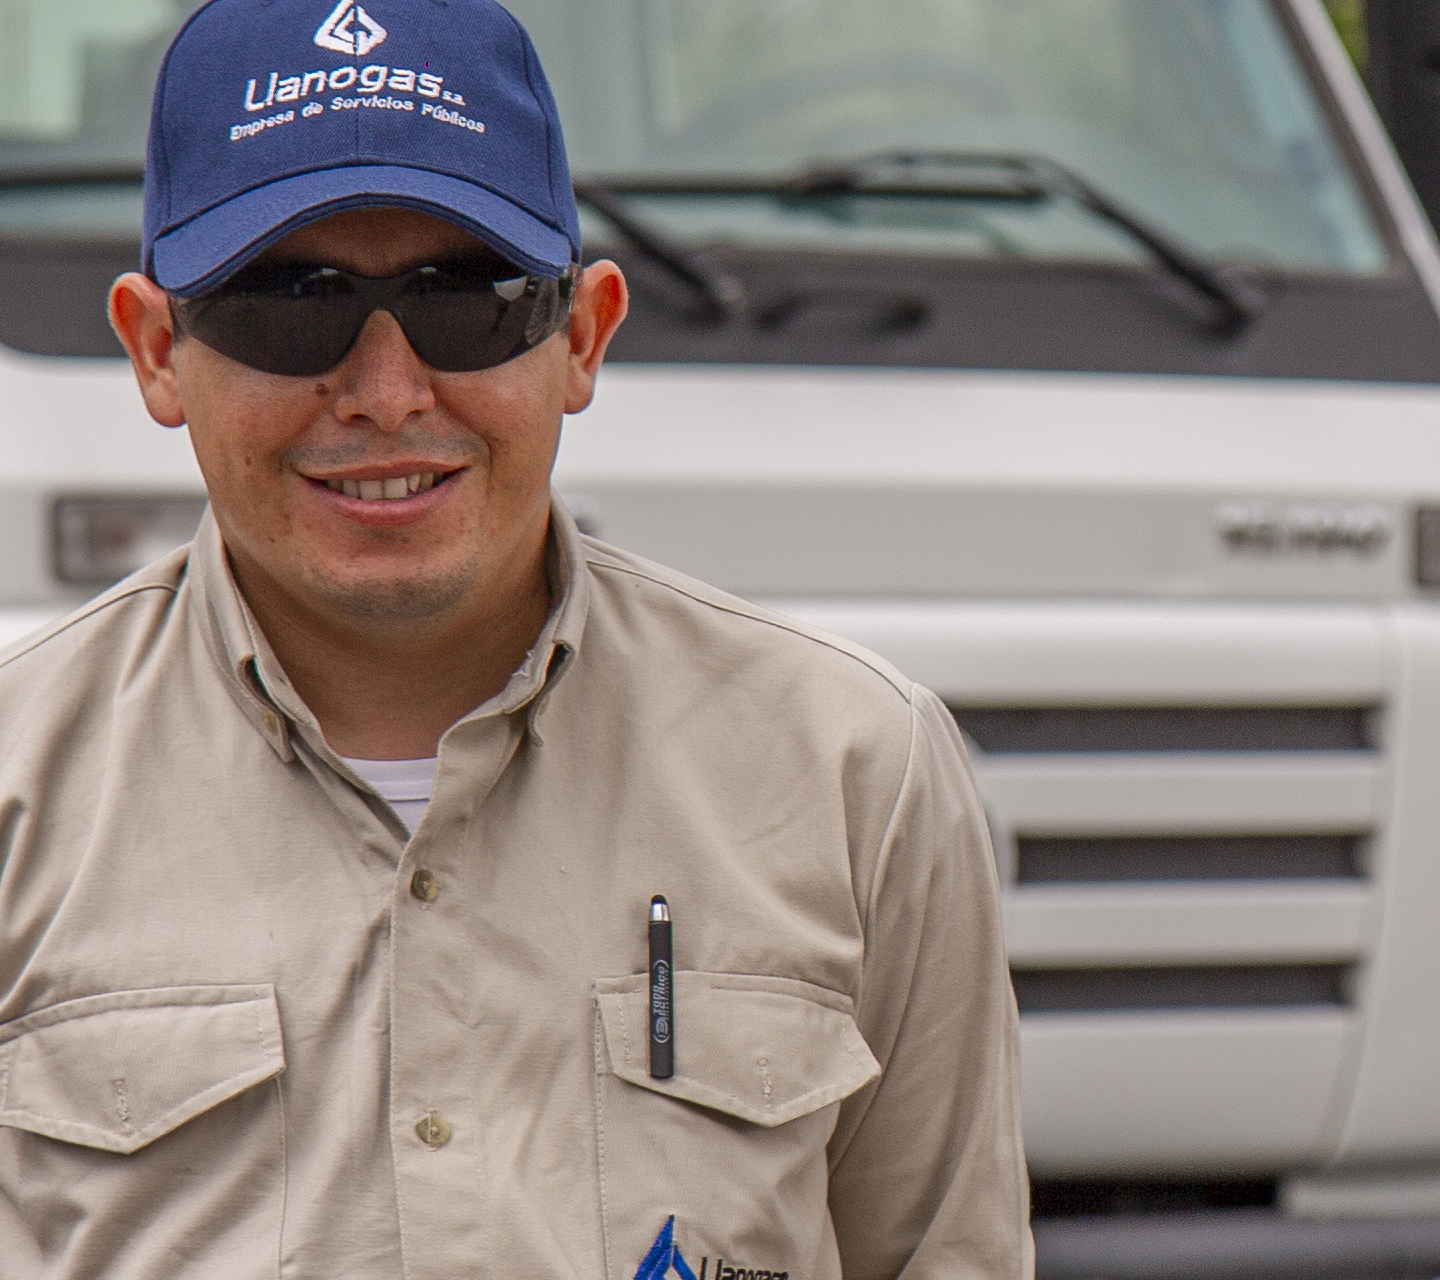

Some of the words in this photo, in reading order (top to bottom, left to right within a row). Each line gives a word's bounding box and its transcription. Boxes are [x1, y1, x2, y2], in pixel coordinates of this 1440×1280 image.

[243, 64, 444, 112] Llanogas
[229, 109, 295, 142] Empresa
[301, 101, 324, 118] de
[330, 96, 415, 111] Servicios
